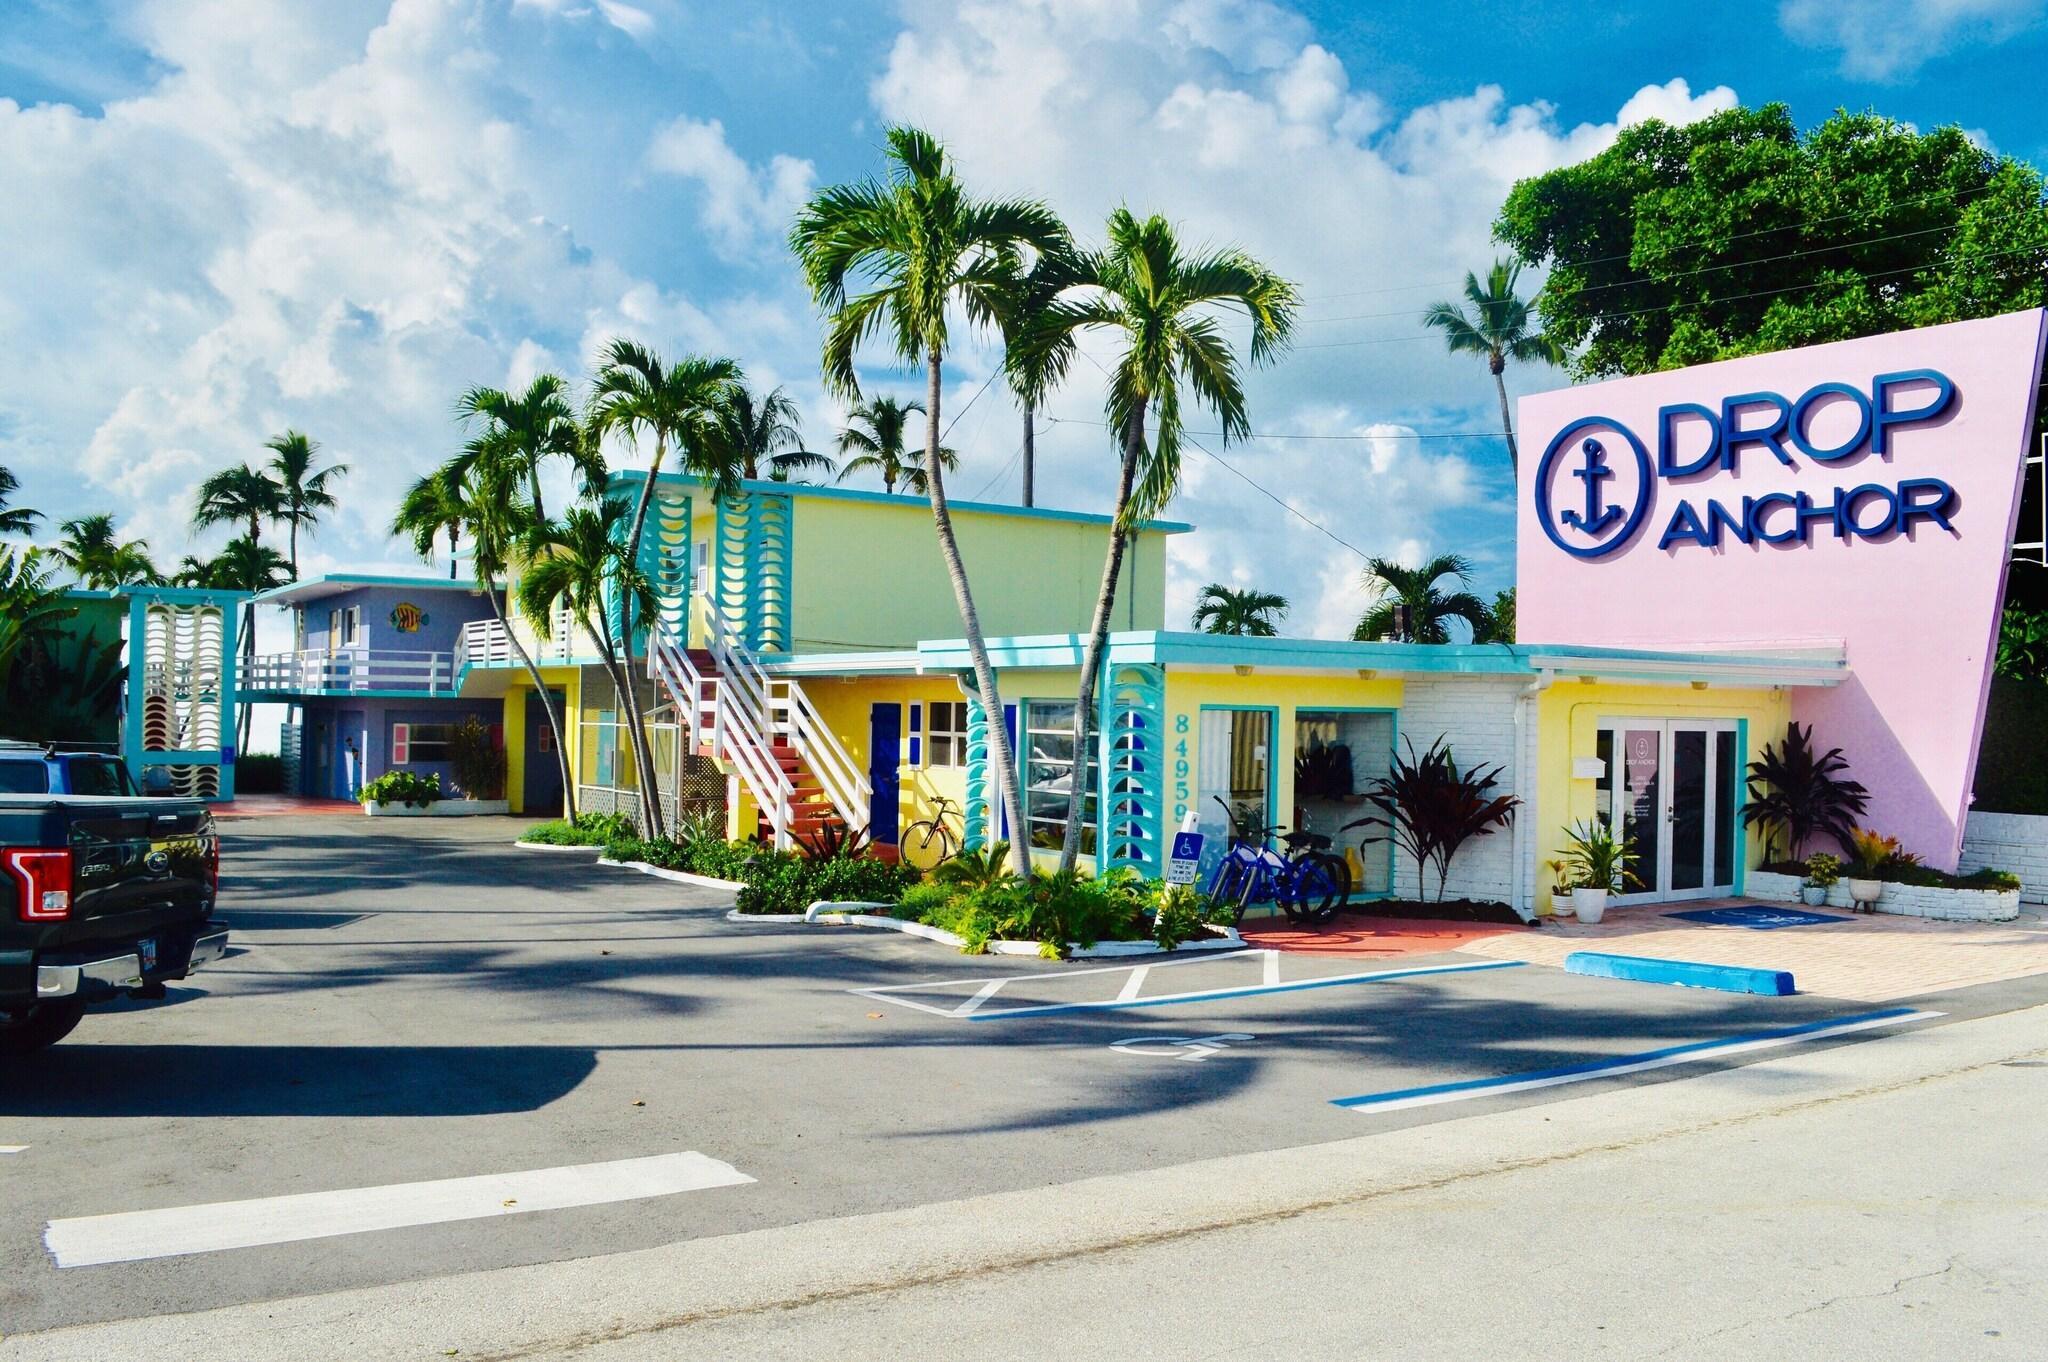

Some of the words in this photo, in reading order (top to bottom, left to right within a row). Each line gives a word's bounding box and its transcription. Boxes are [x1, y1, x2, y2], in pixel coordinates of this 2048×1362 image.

[1658, 368, 1959, 479] DROP
[1658, 477, 1956, 551] ANCHOR
[1175, 714, 1189, 823] 84959
